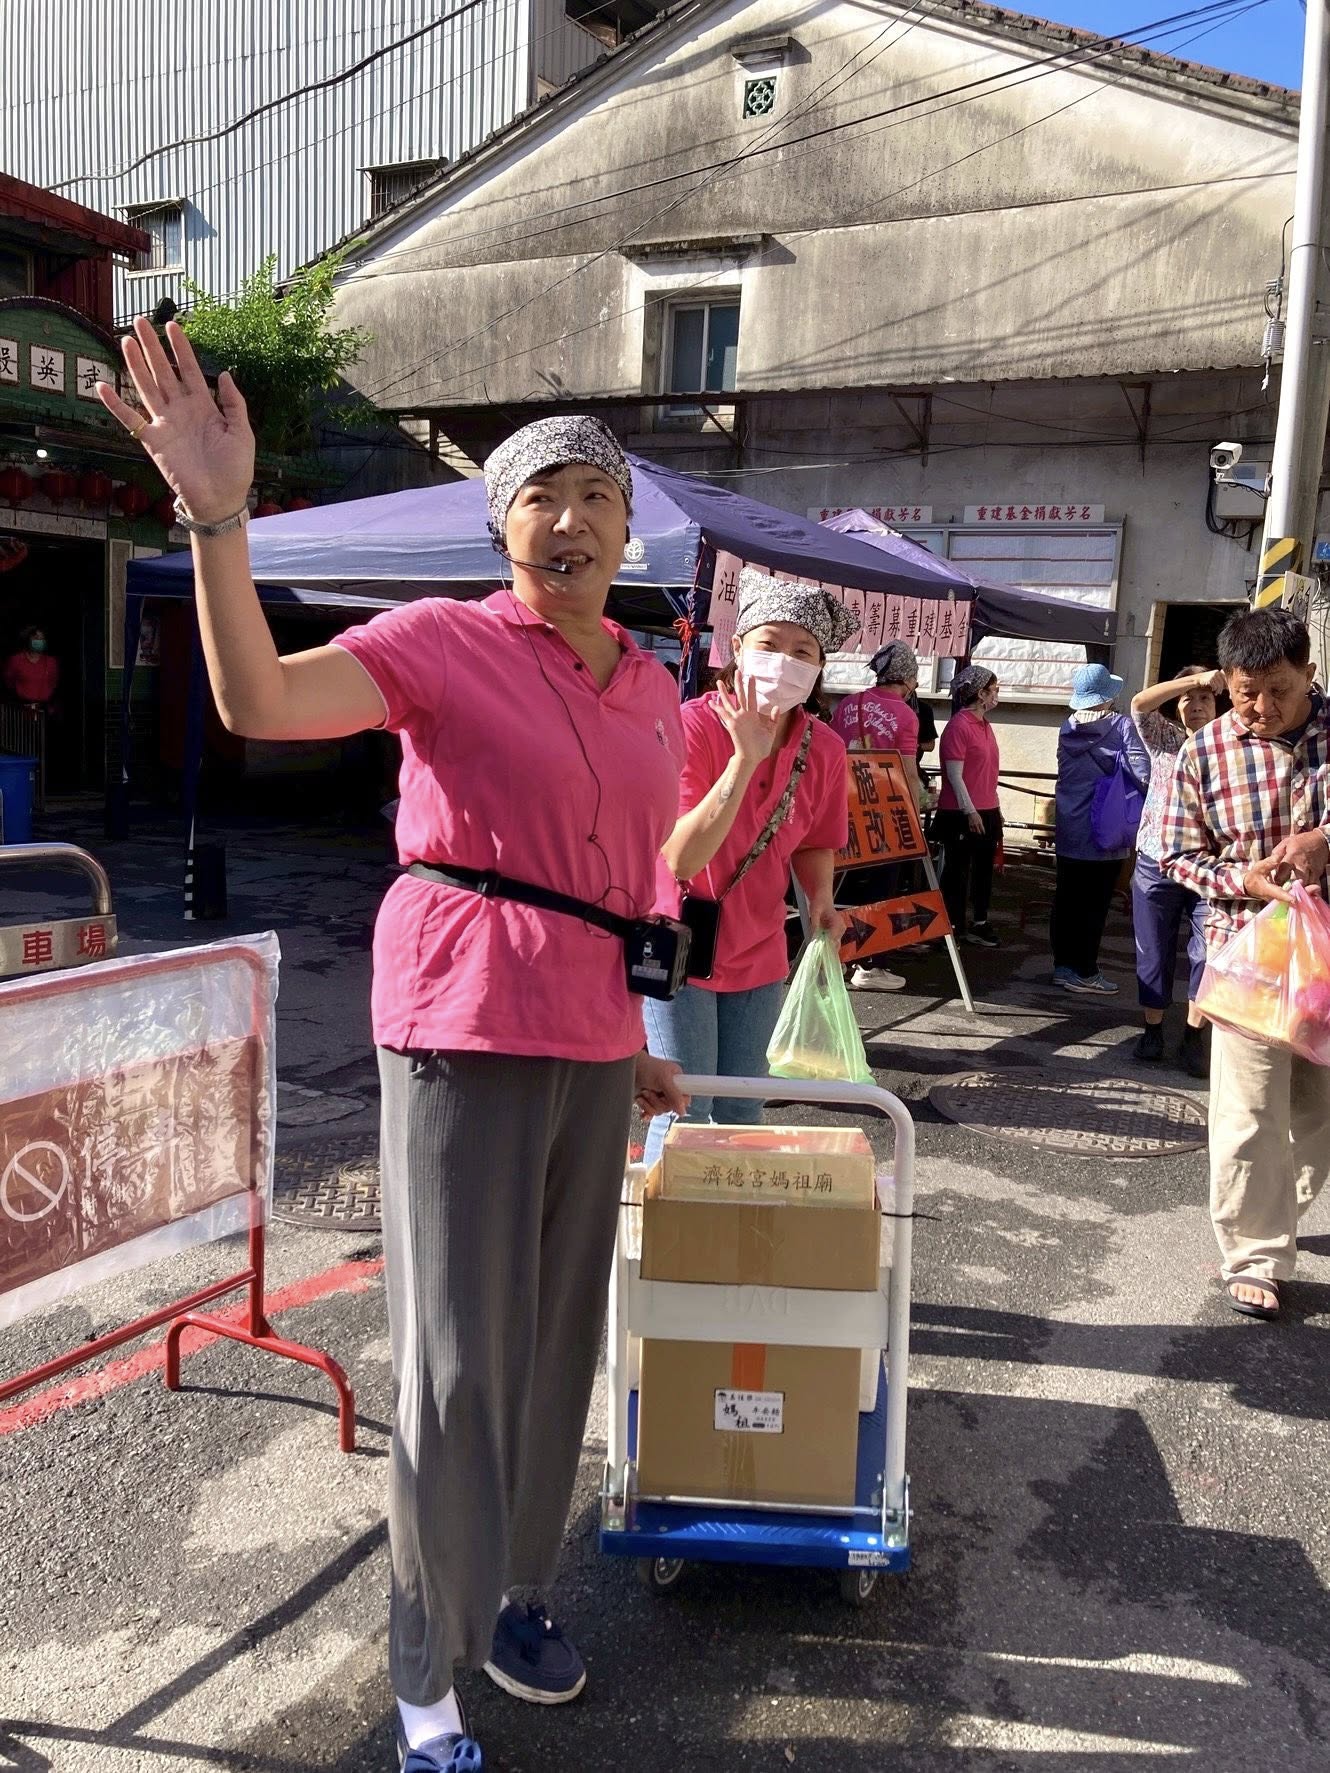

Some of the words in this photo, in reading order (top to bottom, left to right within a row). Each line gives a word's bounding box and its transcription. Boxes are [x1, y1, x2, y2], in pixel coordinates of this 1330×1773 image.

[976, 505, 1091, 521] 重建基金捐獻芳名
[717, 571, 738, 606] 油
[21, 923, 106, 966] 車場
[702, 1164, 833, 1193] 濟德宮媽祖廟
